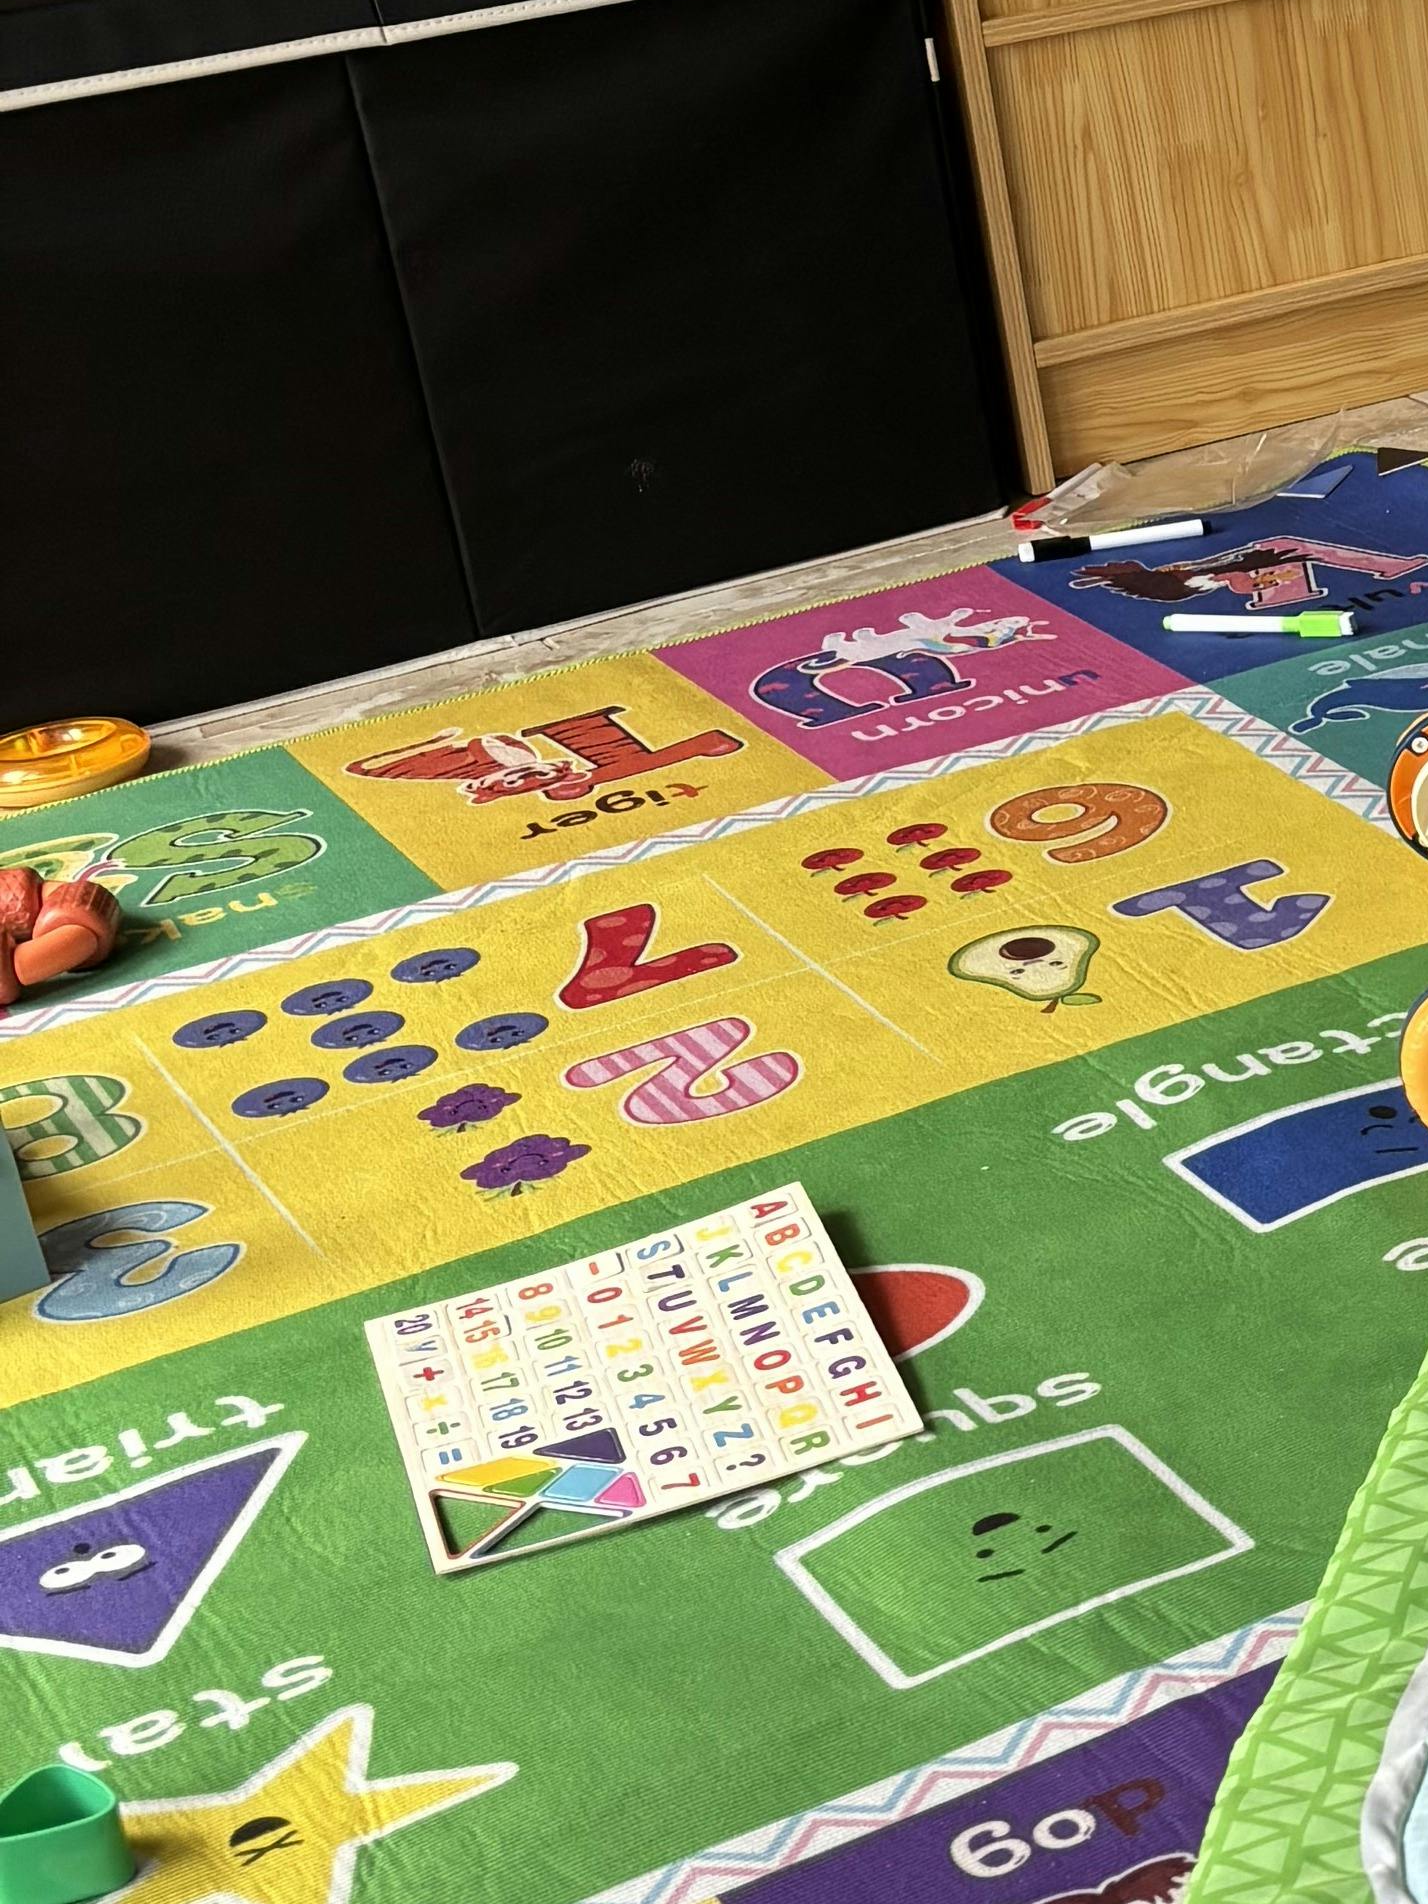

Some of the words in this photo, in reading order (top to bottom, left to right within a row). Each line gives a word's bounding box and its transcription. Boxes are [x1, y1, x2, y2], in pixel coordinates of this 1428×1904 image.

[850, 669, 1103, 742] unicorn
[519, 783, 709, 840] tiger
[121, 881, 318, 944] snak
[1108, 858, 1334, 953] 1
[555, 900, 744, 1011] 7
[561, 1015, 804, 1127] 2
[1051, 1011, 1408, 1142] ctangle
[750, 1201, 788, 1218] A
[765, 1223, 800, 1245] B
[32, 1199, 247, 1323] 3
[637, 1240, 671, 1260] S
[706, 1244, 744, 1268] K
[648, 1264, 685, 1280] T
[777, 1251, 812, 1272] C
[518, 1283, 553, 1300] 8
[718, 1272, 753, 1292] L
[789, 1275, 825, 1295] D
[457, 1298, 494, 1319] 14
[658, 1290, 697, 1312] U
[728, 1294, 769, 1320] M
[525, 1306, 562, 1321] 9
[598, 1315, 634, 1329] 1
[802, 1301, 840, 1324] E
[394, 1313, 432, 1335] 20
[464, 1320, 501, 1343] 15
[669, 1316, 707, 1335] V
[739, 1321, 780, 1345] N
[535, 1329, 573, 1350] 10
[815, 1328, 853, 1344] F
[606, 1339, 643, 1357] 2
[678, 1339, 720, 1365] W
[544, 1356, 582, 1376] 11
[754, 1350, 791, 1370] O
[828, 1356, 866, 1379] G
[481, 1372, 520, 1391] 17
[617, 1364, 654, 1382] 3
[690, 1370, 729, 1391] X
[553, 1381, 592, 1404] 12
[765, 1375, 804, 1394] P
[840, 1381, 882, 1406] H
[490, 1398, 528, 1421] 18
[629, 1393, 665, 1409] 4
[703, 1396, 742, 1414] Y
[563, 1408, 603, 1431] 13
[639, 1417, 678, 1436] 5
[499, 1426, 539, 1448] 19
[713, 1423, 754, 1447] Z
[790, 1430, 830, 1455] R
[650, 1446, 687, 1465] 6
[661, 1473, 700, 1489] 7
[950, 1777, 1166, 1878] dog
